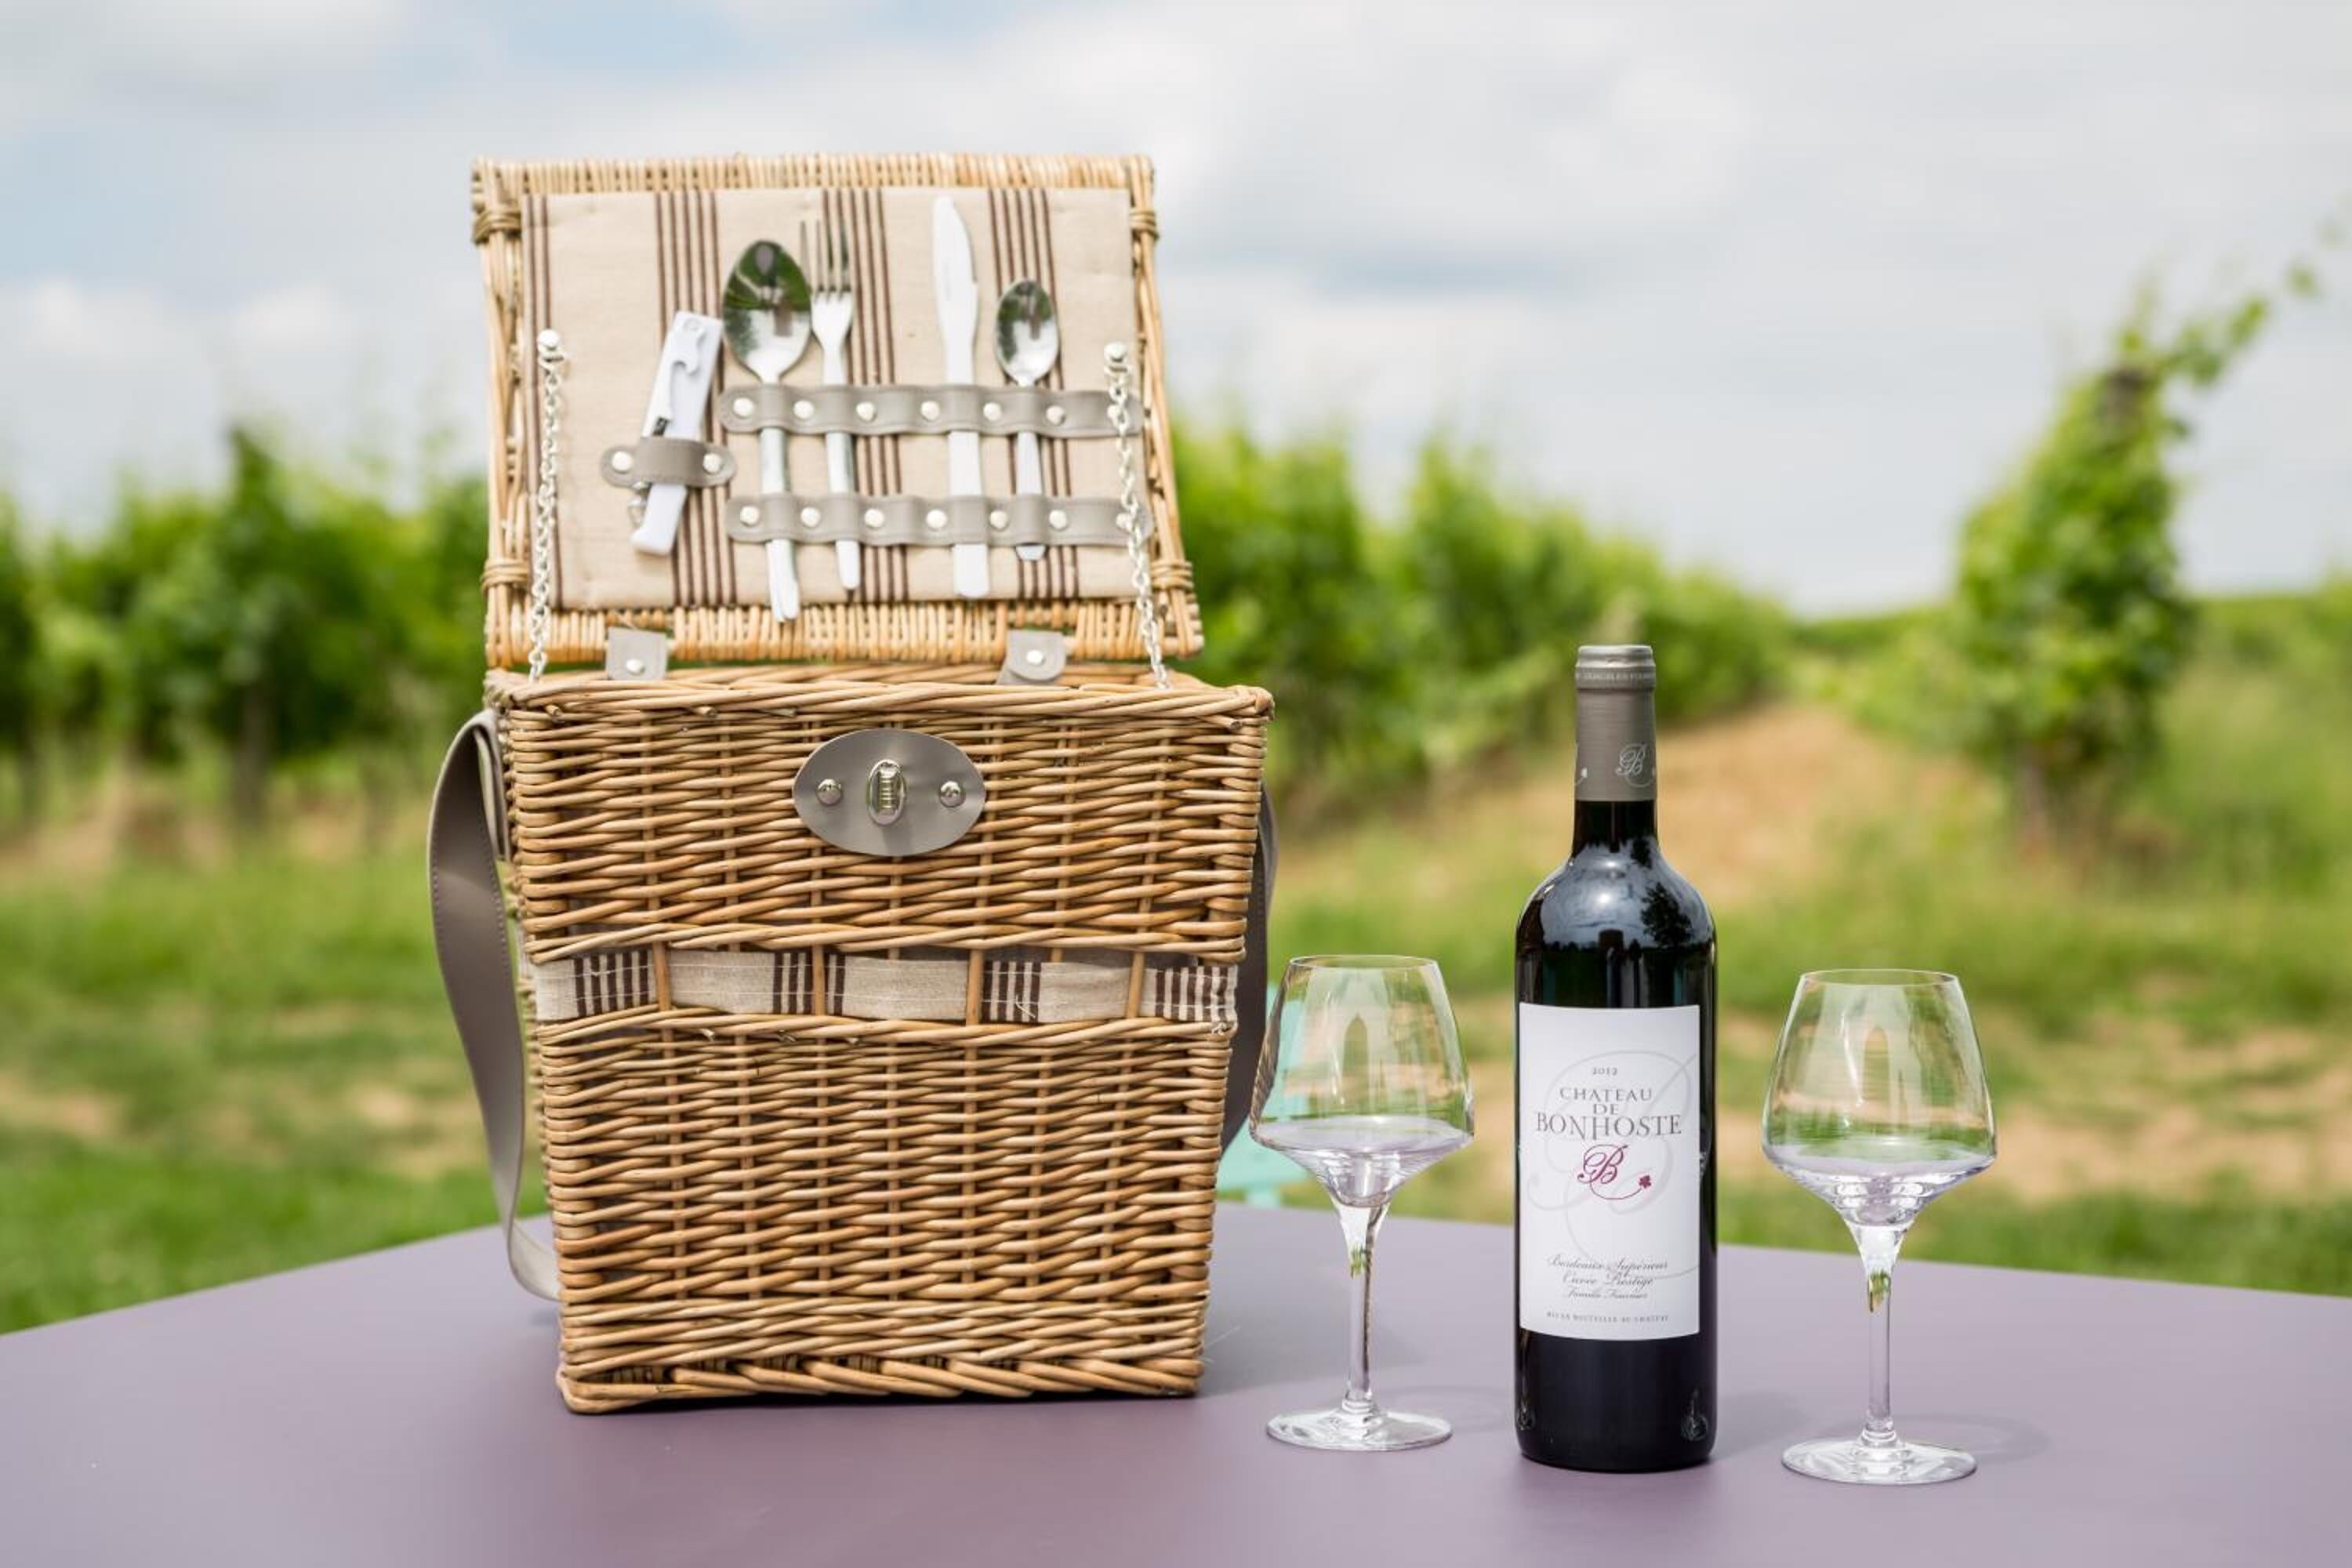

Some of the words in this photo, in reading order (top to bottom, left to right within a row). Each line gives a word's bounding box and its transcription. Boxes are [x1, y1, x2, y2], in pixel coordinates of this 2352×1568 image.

[1559, 1087, 1653, 1102] CHATEAU
[1592, 1104, 1619, 1116] DE
[1535, 1112, 1682, 1141] BONHOSTE
